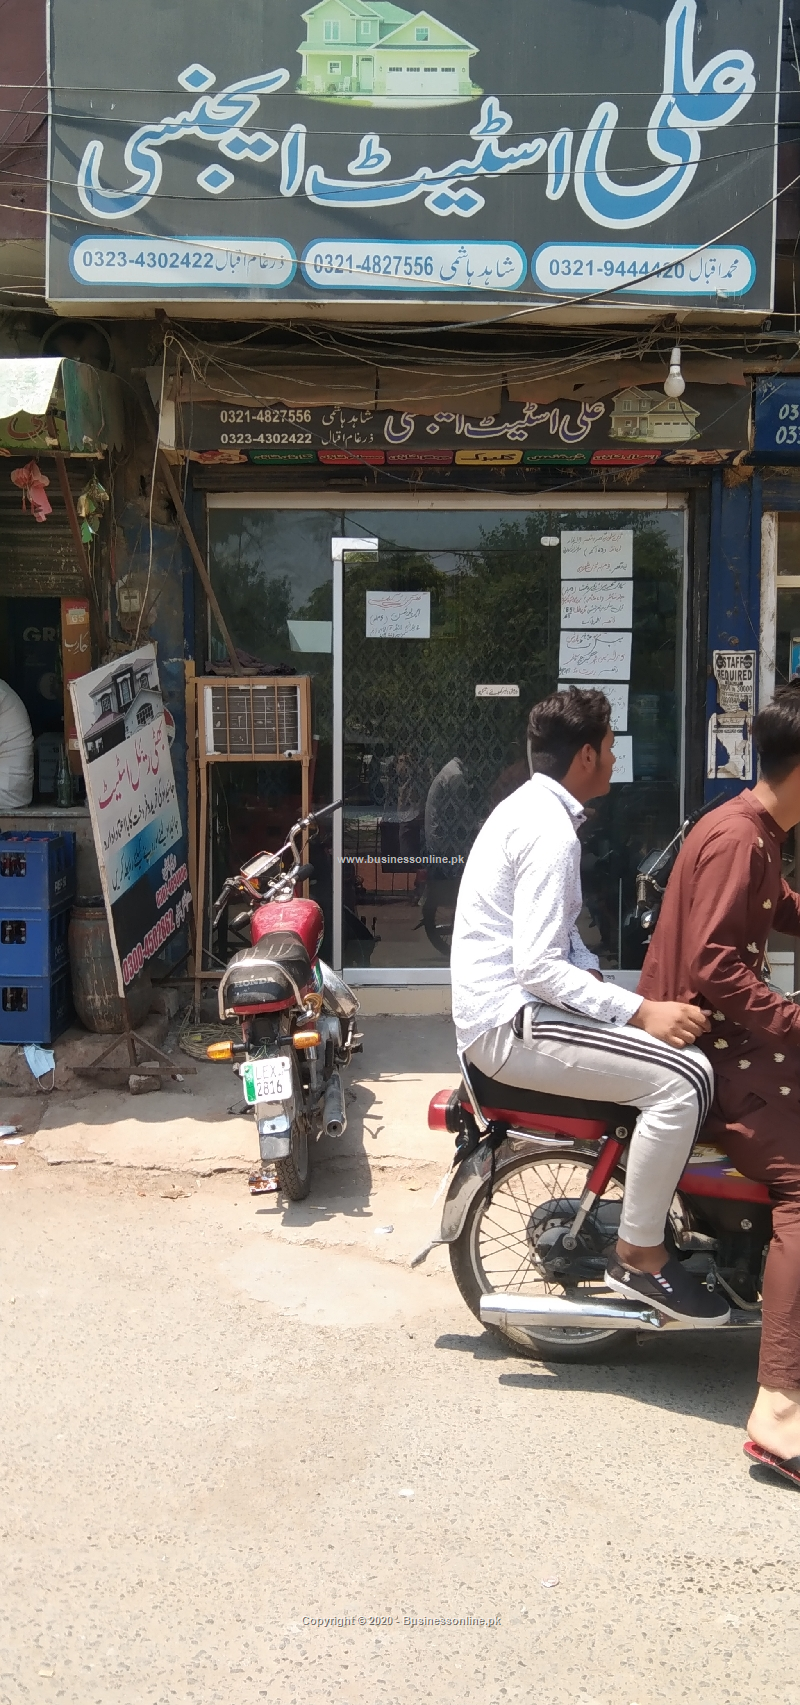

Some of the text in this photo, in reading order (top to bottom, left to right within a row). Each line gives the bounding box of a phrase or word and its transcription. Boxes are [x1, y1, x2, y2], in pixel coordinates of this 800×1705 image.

[78, 0, 756, 229] علی اسٹیٹ ایجنسی
[82, 250, 214, 268] 0323-4302422
[313, 245, 516, 286] شاہد ہاشمی 0321-4827556
[549, 258, 685, 279] 0321-9444420
[689, 256, 722, 284] اقبال
[219, 409, 312, 424] 0321-4827556
[346, 409, 374, 429] شاہد
[464, 401, 559, 441] اسٹیٹ
[559, 400, 605, 443] علی
[220, 433, 312, 444] 0323-4302422
[722, 656, 744, 668] STAFF
[716, 669, 752, 681] REQUIRED
